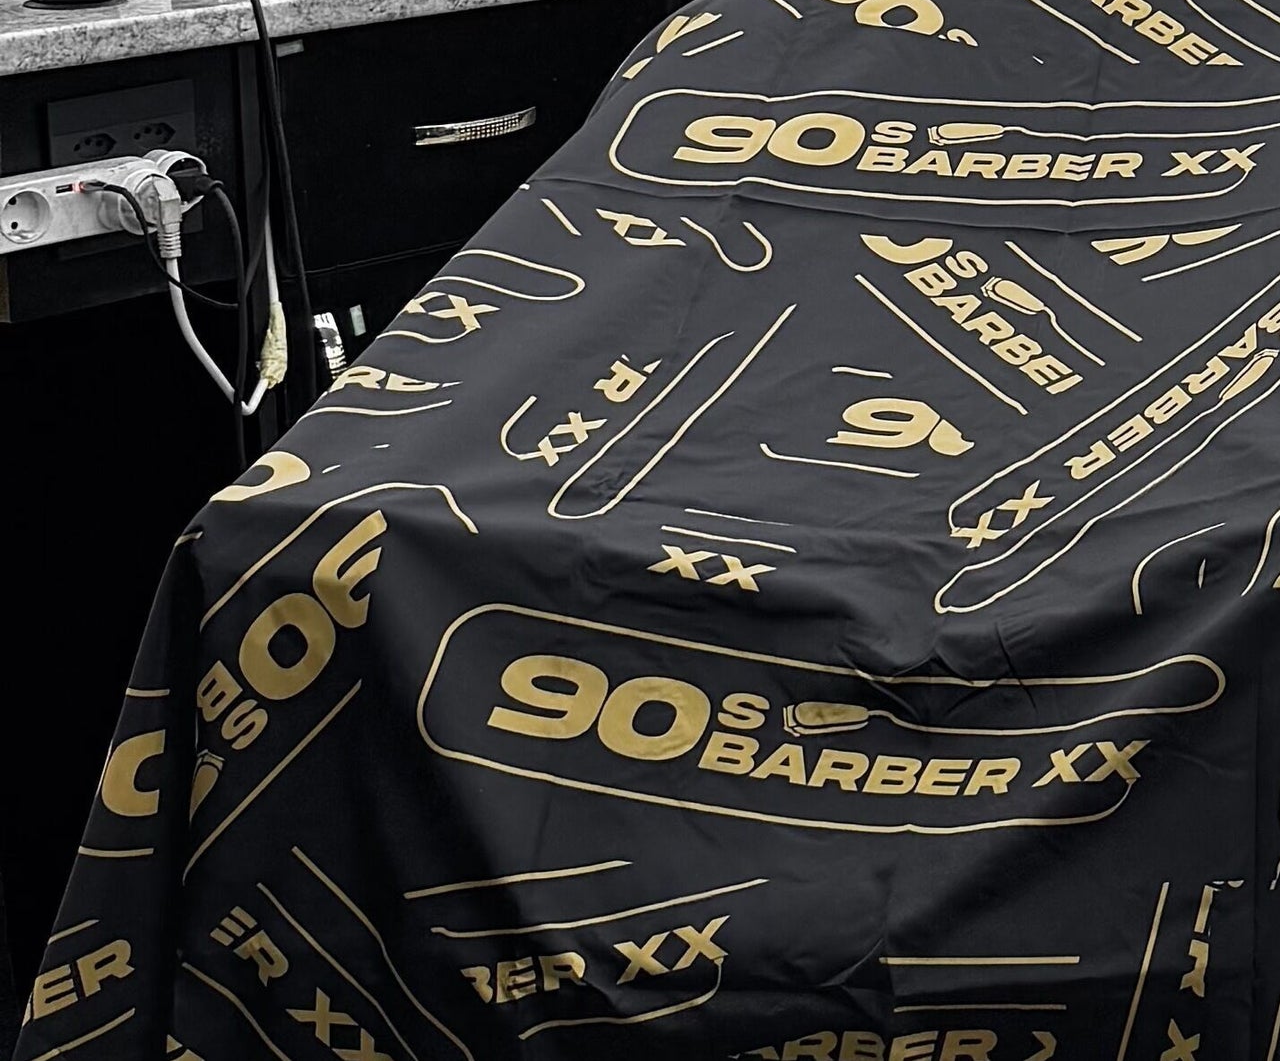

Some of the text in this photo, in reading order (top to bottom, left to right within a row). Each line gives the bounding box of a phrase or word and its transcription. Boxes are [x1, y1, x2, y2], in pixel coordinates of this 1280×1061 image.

[856, 147, 1144, 181] BARBER
[1160, 142, 1266, 179] XX
[536, 410, 608, 467] XX
[949, 479, 1056, 550] XX
[646, 543, 778, 593] XX
[698, 731, 1022, 797] BARBER
[1031, 739, 1152, 788] XX
[613, 914, 732, 987] XX
